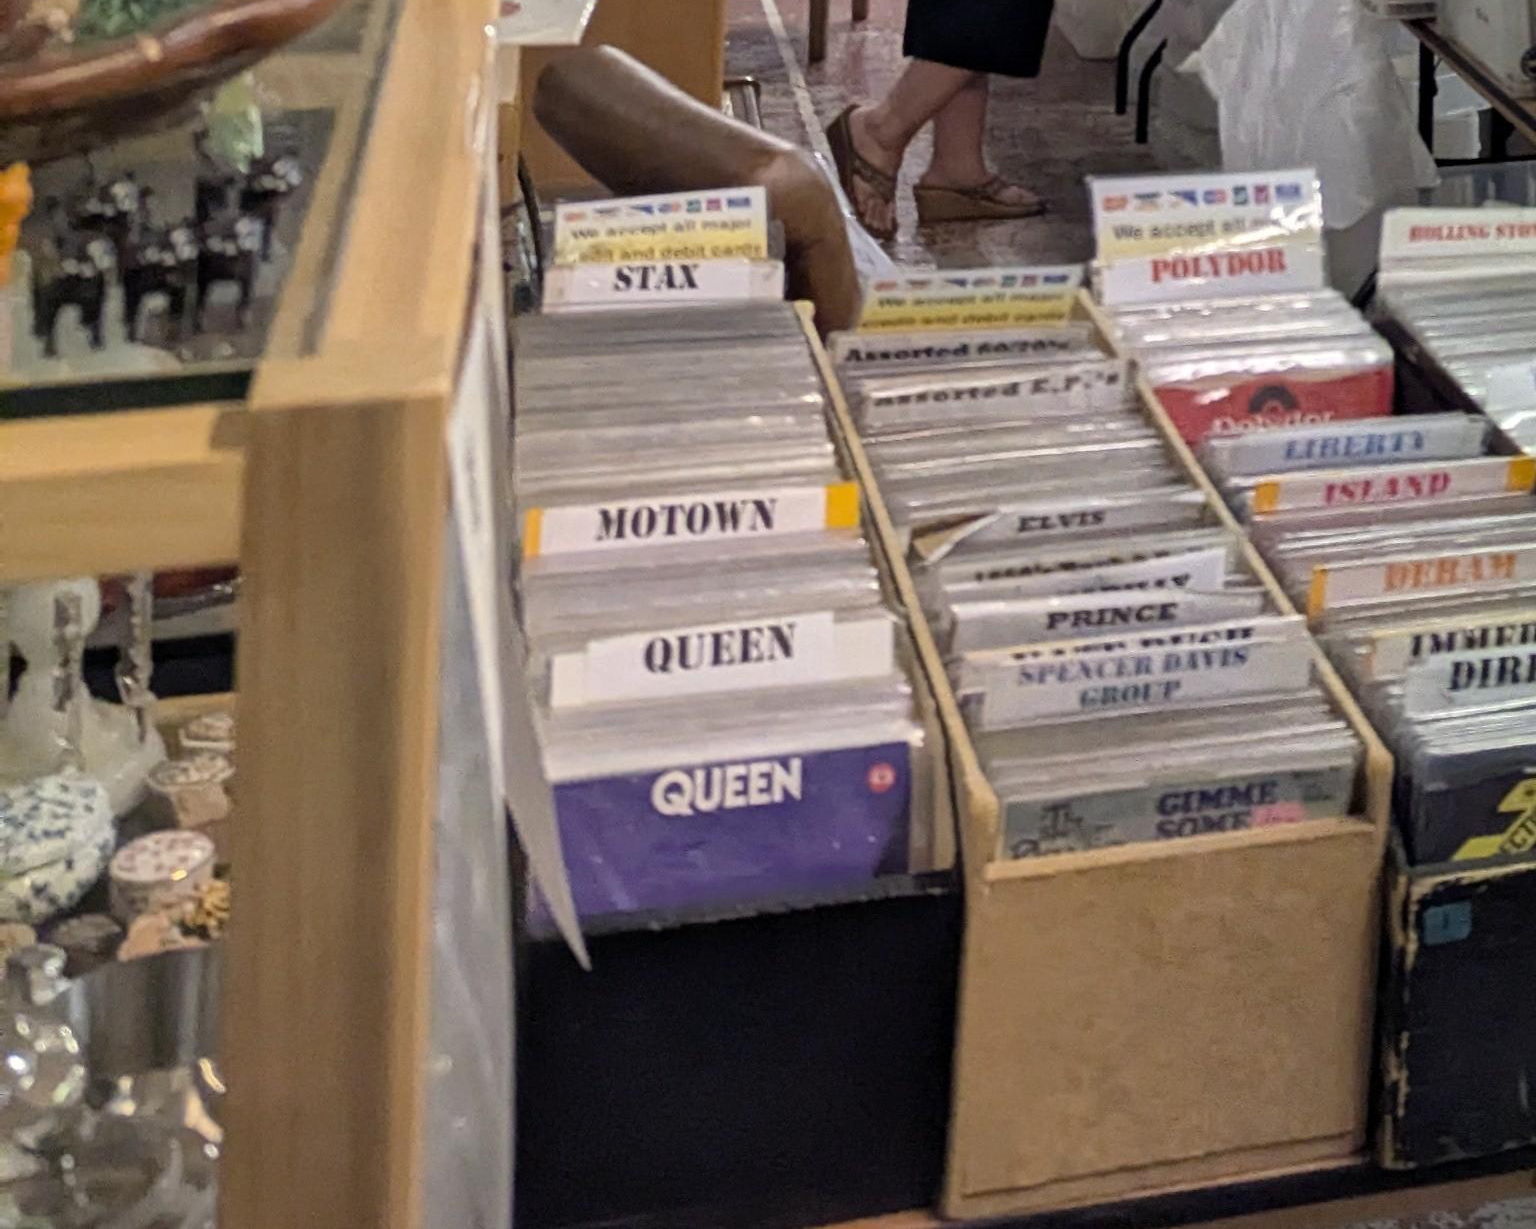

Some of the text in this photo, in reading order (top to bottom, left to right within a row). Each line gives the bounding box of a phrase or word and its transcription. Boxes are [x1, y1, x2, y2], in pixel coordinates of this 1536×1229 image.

[1113, 224, 1144, 240] We
[1151, 220, 1215, 238] accept
[1408, 222, 1489, 243] ROLLING
[613, 263, 699, 291] STAX
[1151, 248, 1286, 282] POLYDOR
[846, 343, 969, 363] Assorted
[873, 381, 1021, 407] Assorted
[1284, 430, 1426, 461] LIBERTY
[1323, 471, 1451, 506] ISLAND
[595, 498, 777, 541] MOTOWN
[1017, 510, 1106, 533] ELVIS
[1383, 552, 1517, 593] DERAM
[1045, 602, 1179, 631] PRINCE
[644, 623, 796, 674] QUEEN
[1017, 646, 1251, 686] SPENCER DAVIS
[1079, 679, 1182, 708] GROUP
[650, 758, 803, 817] QUEEN
[1156, 780, 1279, 817] GIMME
